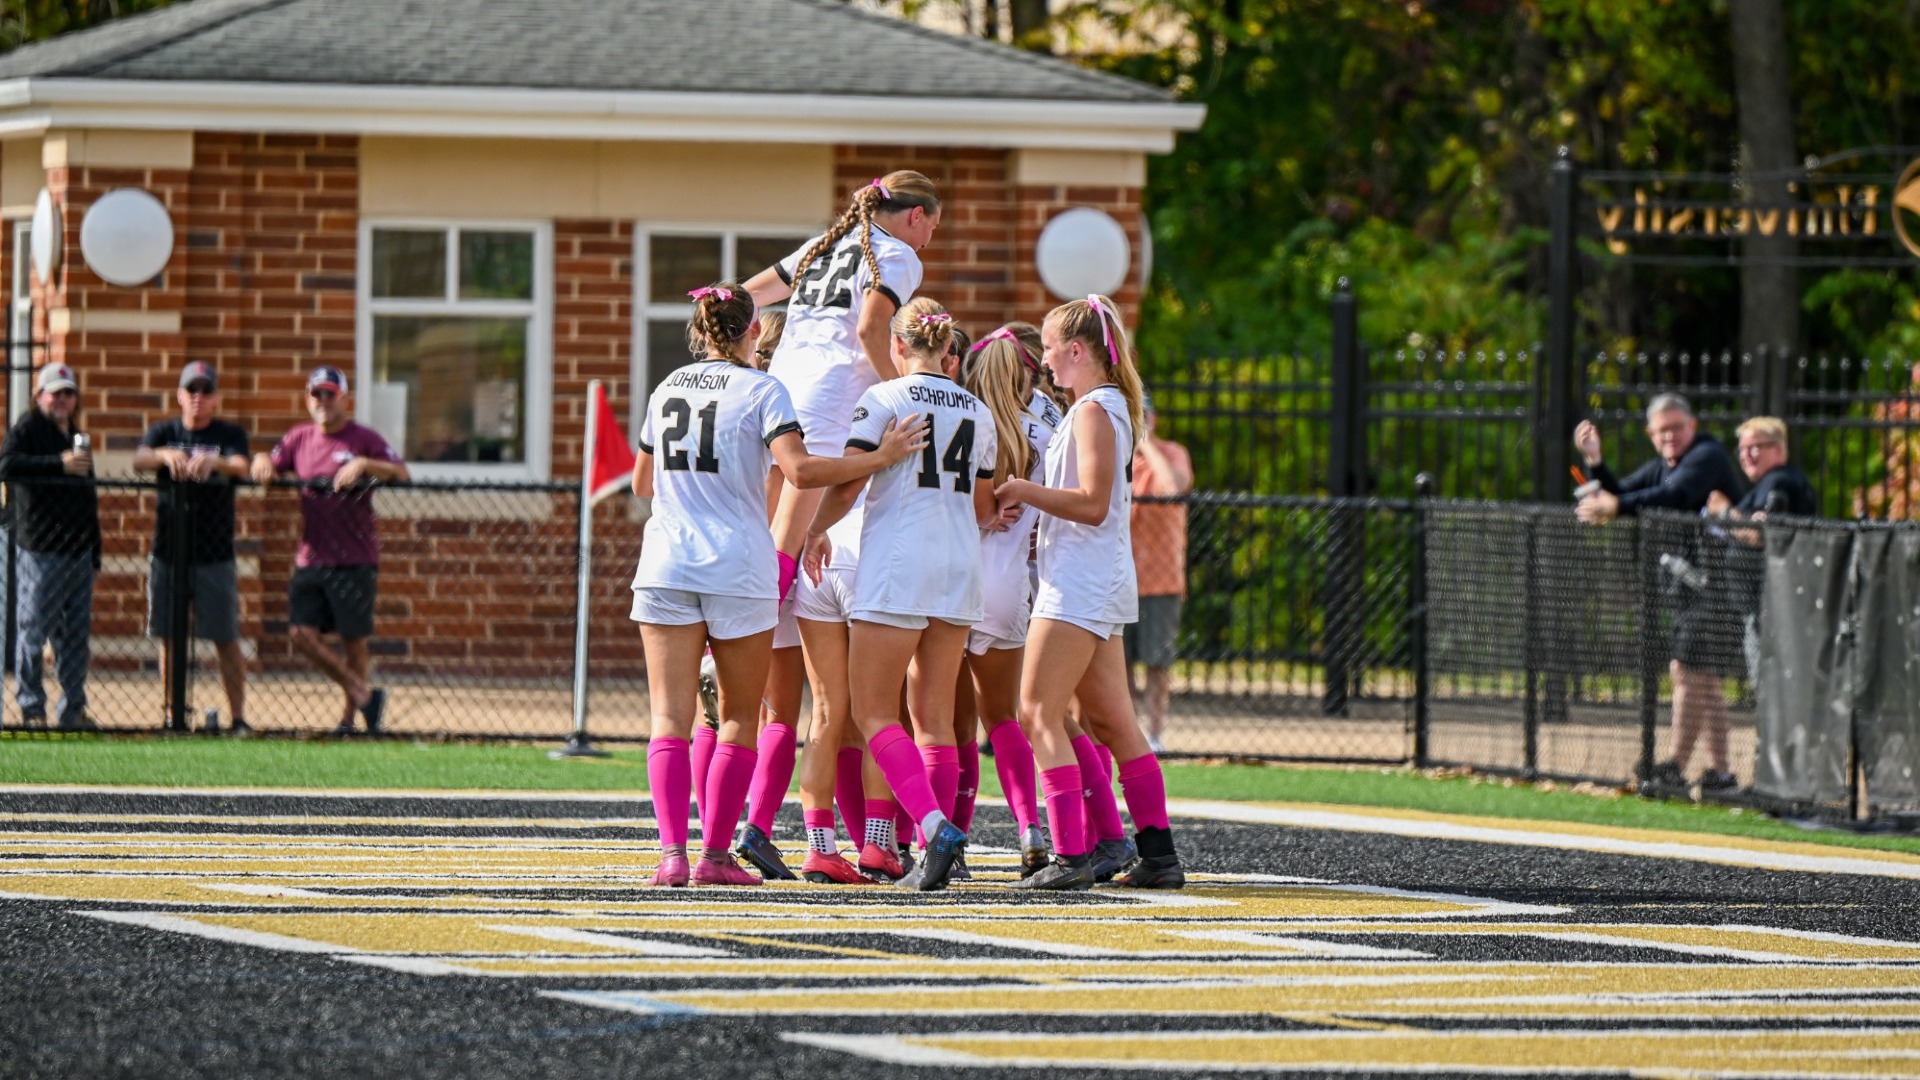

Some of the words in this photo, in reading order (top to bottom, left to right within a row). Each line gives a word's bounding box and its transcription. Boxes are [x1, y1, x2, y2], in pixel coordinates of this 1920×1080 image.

[792, 244, 863, 309] 22
[667, 372, 730, 390] JOHNSON
[909, 386, 977, 413] SCHRUMPF
[662, 397, 720, 474] 21
[917, 412, 975, 495] 14
